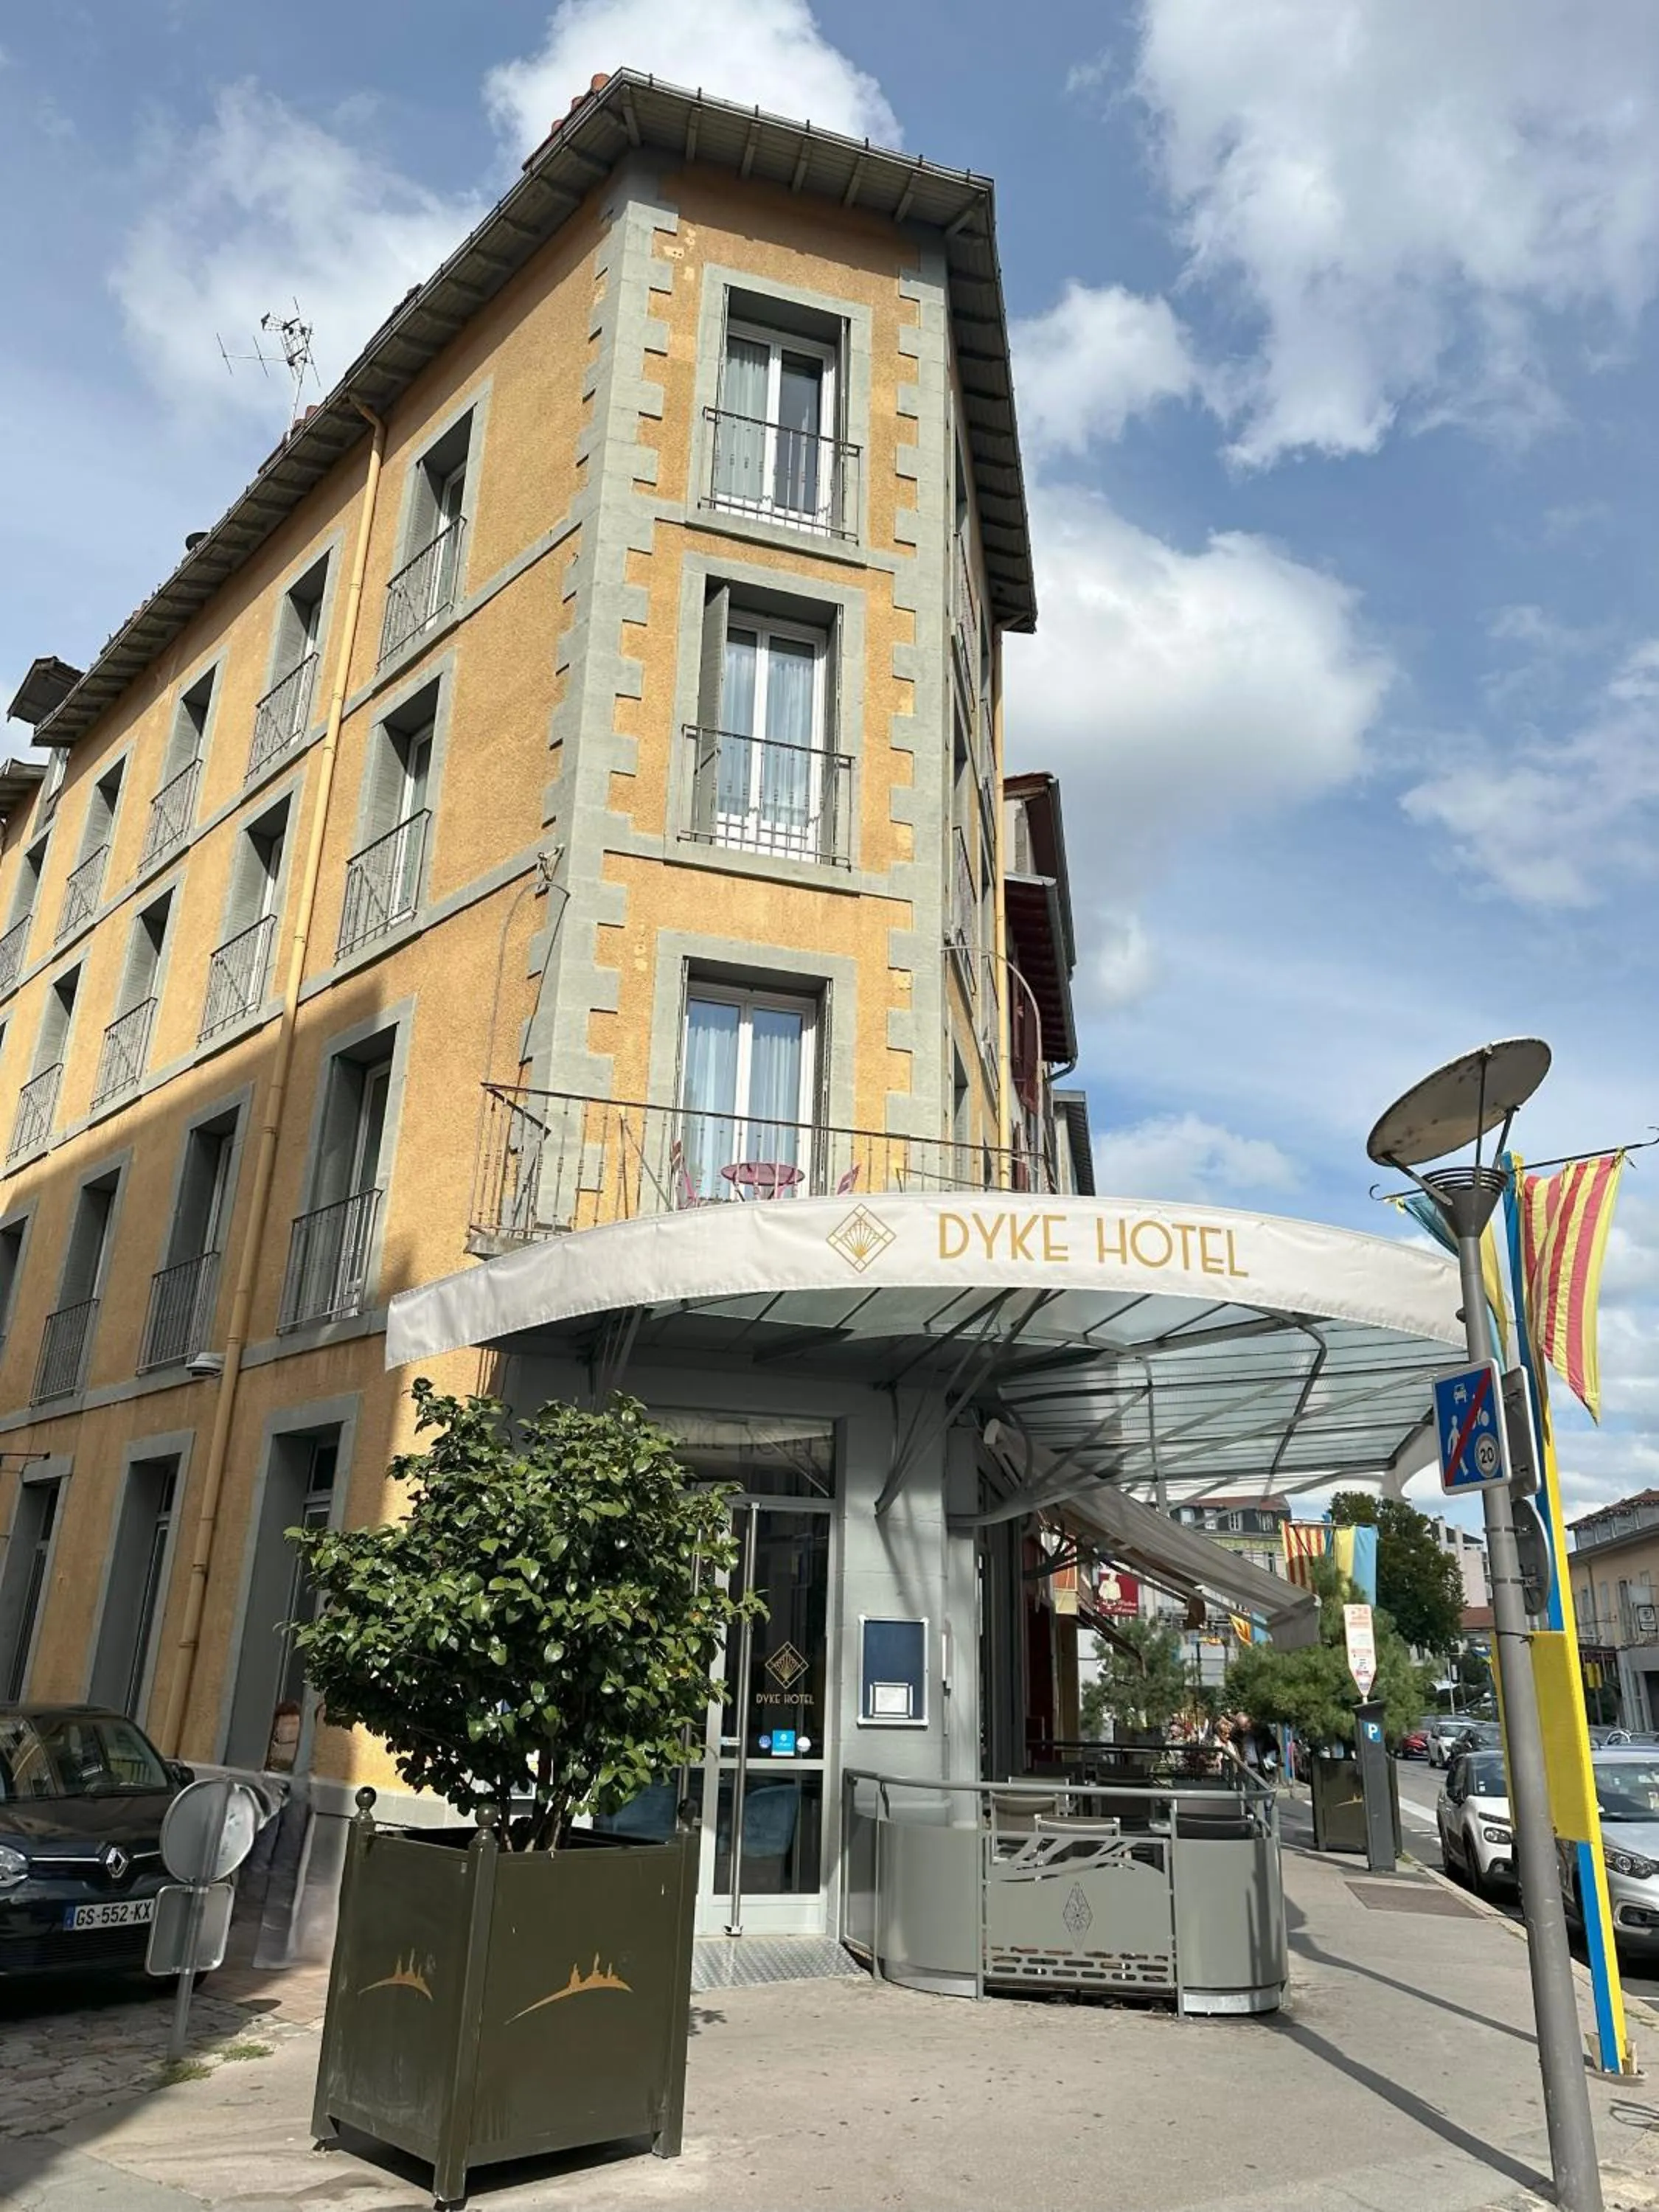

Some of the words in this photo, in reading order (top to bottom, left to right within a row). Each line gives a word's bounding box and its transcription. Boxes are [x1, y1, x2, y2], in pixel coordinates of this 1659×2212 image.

[939, 1212, 1069, 1262] DYKE
[1096, 1217, 1249, 1278] HOTEL
[1480, 1446, 1495, 1464] 20
[756, 1693, 781, 1705] DYKE
[784, 1693, 815, 1705] HOTEL
[1368, 1722, 1378, 1740] P
[76, 1902, 151, 1926] GS-552-KX
